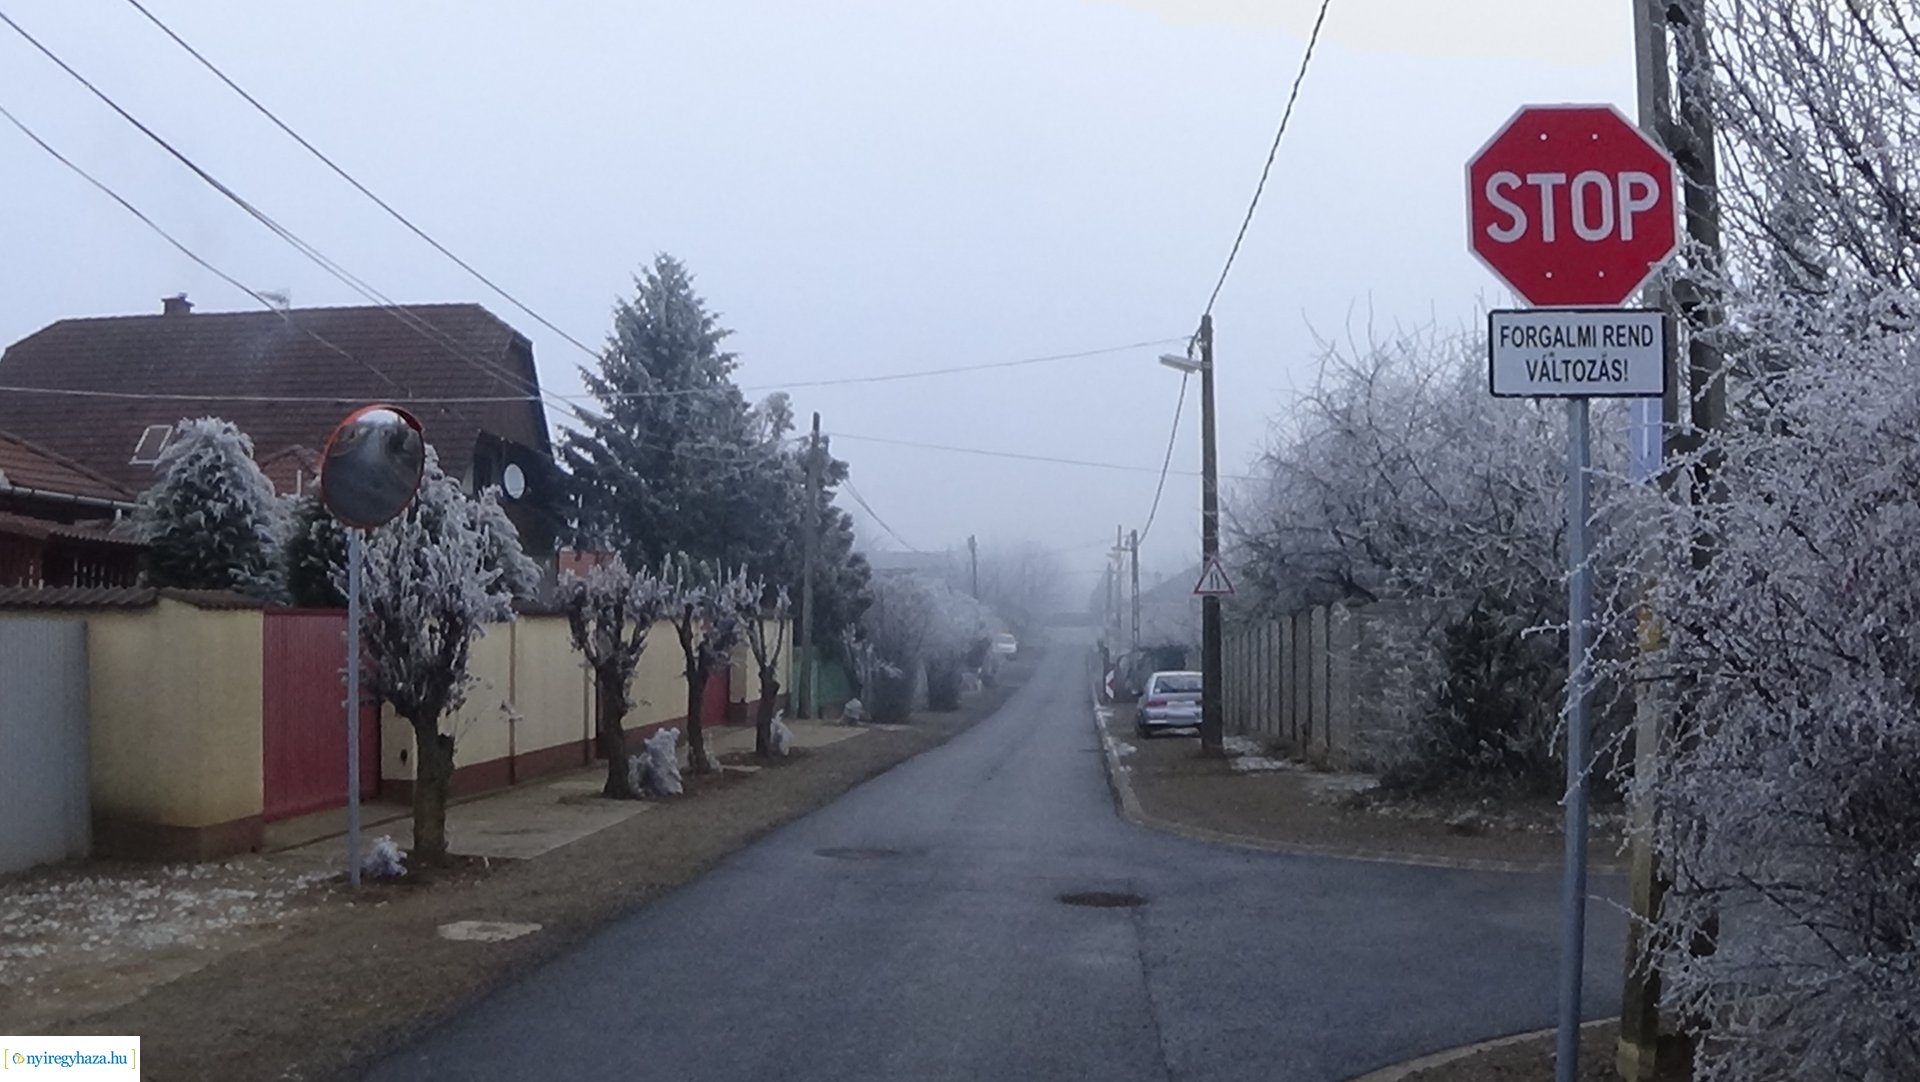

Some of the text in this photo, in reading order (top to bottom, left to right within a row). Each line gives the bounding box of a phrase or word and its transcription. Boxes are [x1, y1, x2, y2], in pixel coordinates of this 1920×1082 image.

[1485, 170, 1660, 243] STOP
[1500, 324, 1654, 348] FORGALMI REND
[1526, 351, 1629, 383] VÁLTOZÁS!
